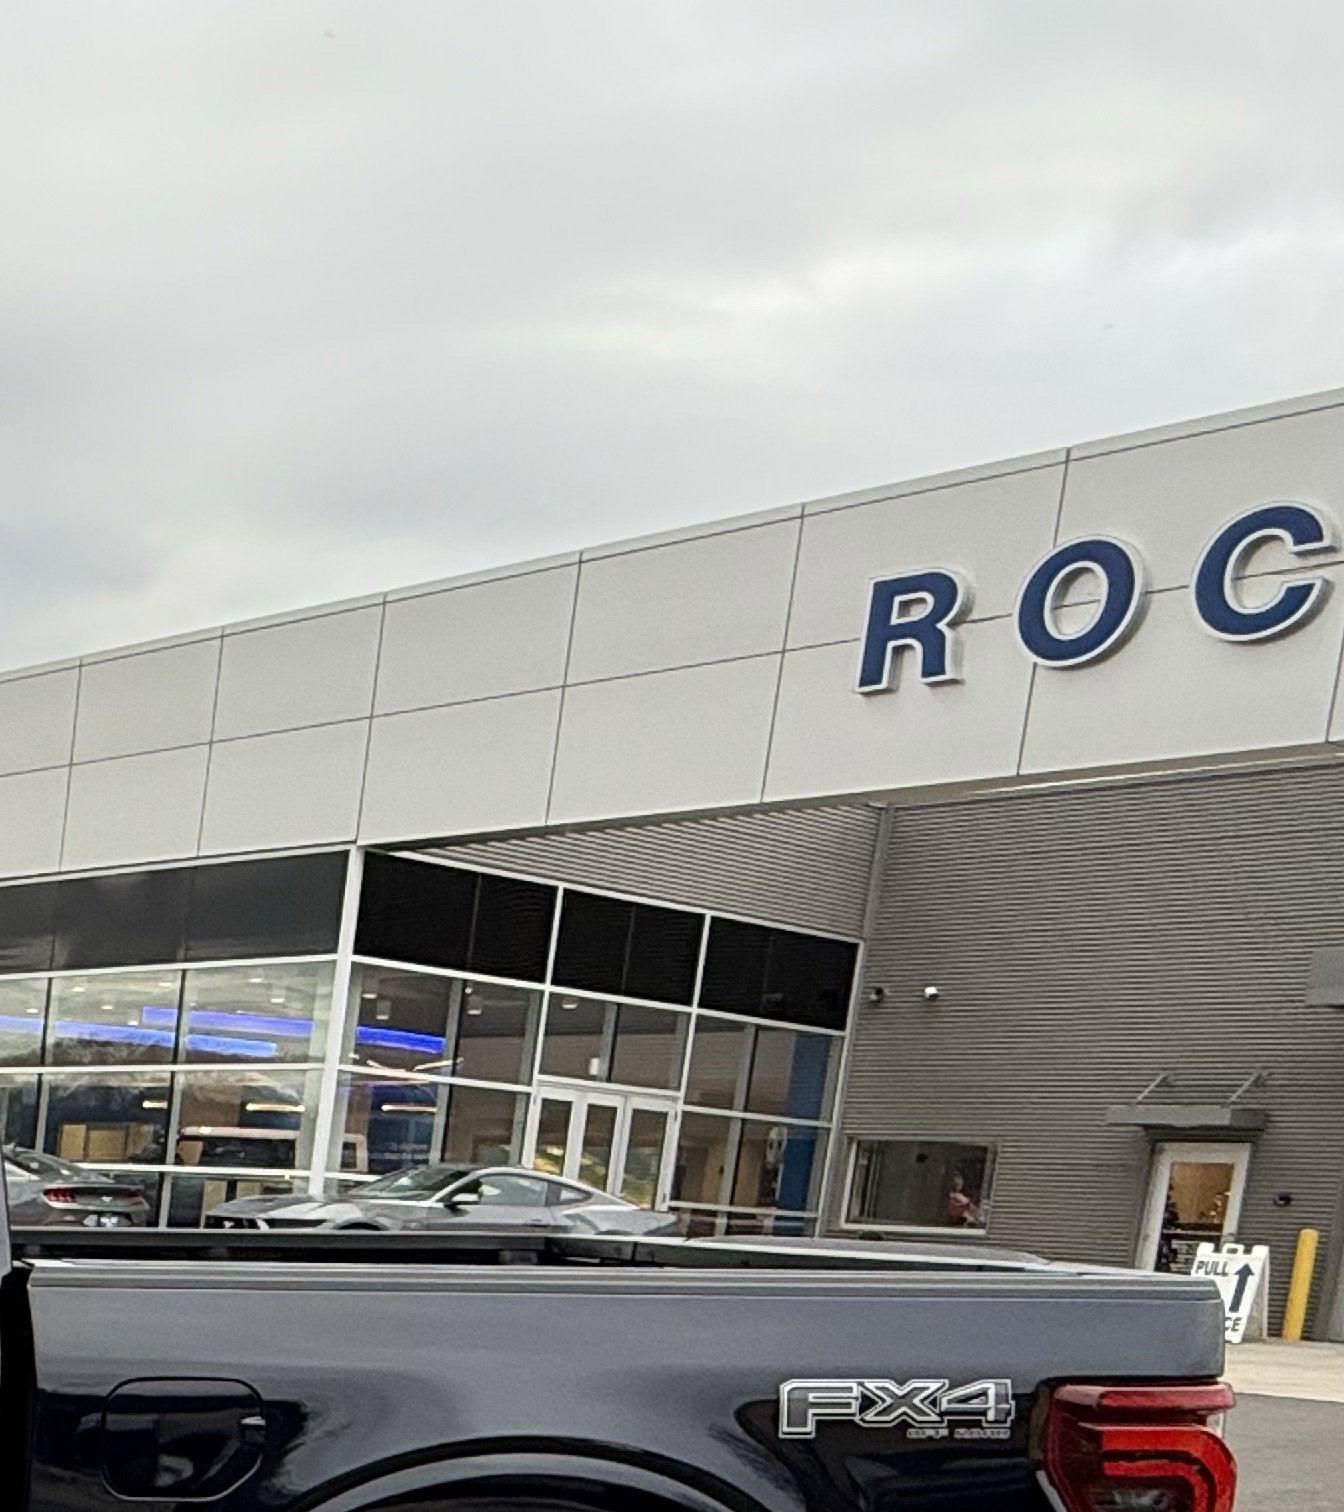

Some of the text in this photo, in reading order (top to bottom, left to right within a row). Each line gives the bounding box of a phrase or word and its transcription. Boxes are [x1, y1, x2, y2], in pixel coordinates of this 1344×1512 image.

[855, 500, 1337, 695] ROC
[1195, 1260, 1229, 1276] PULL
[779, 1379, 1015, 1439] FX4
